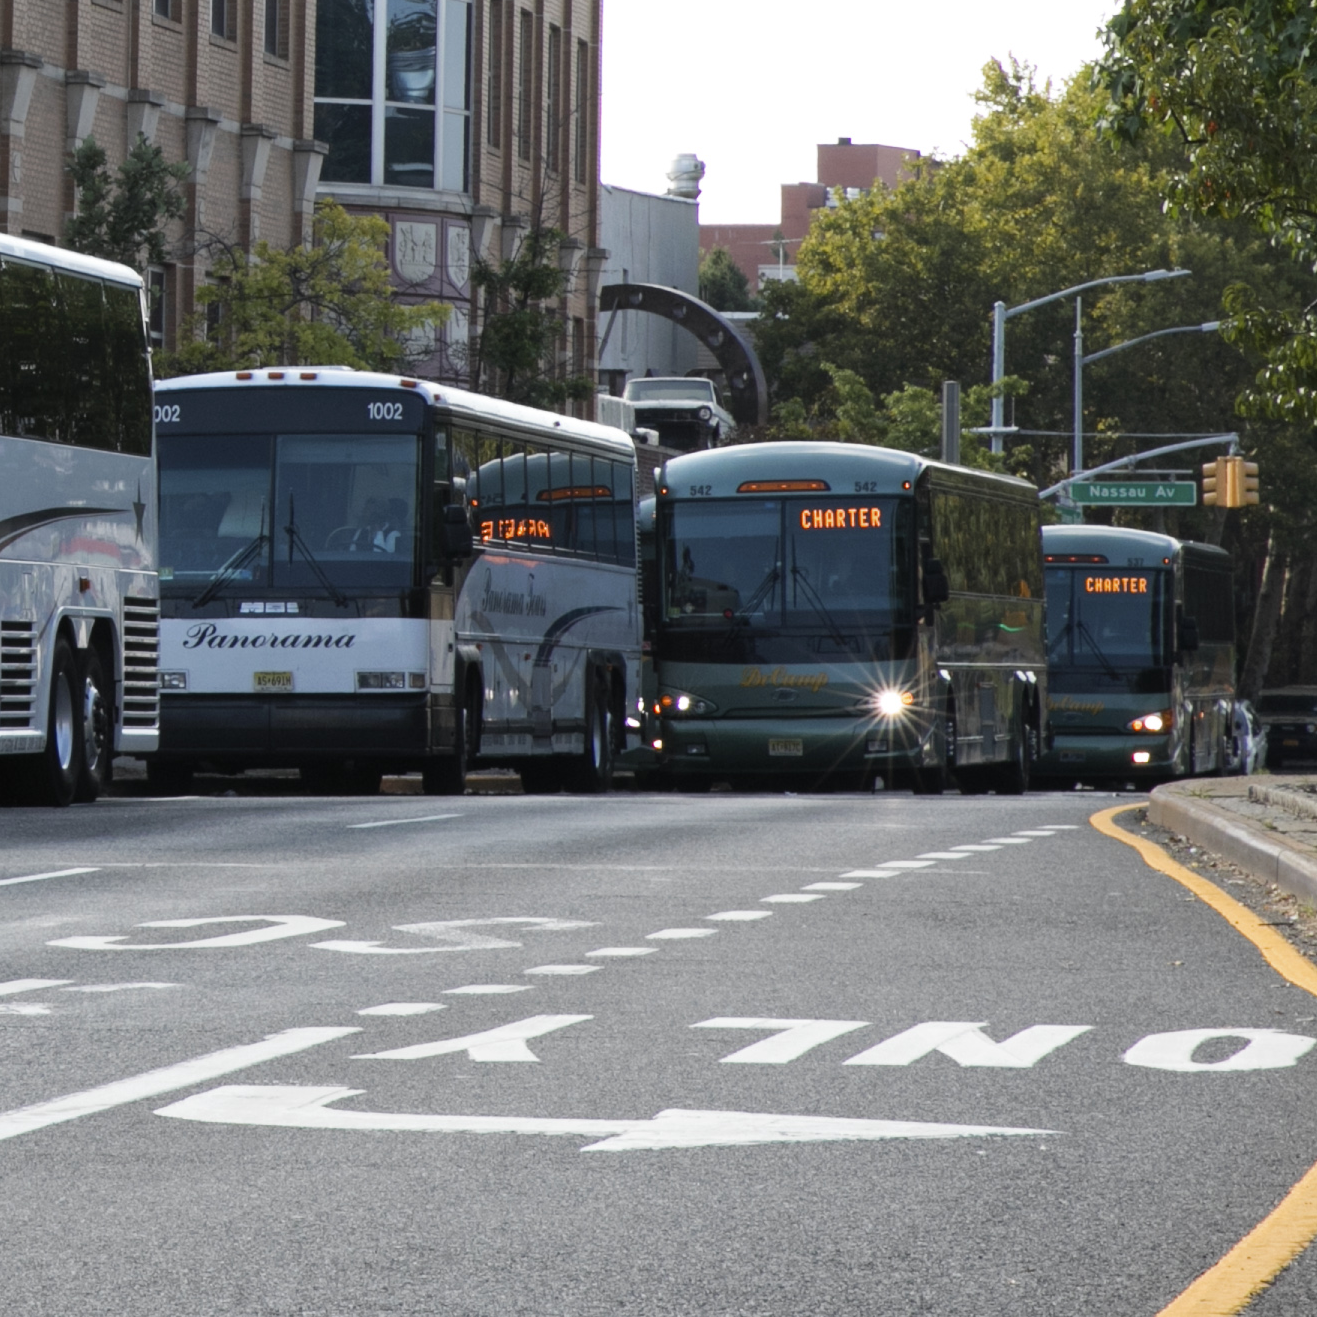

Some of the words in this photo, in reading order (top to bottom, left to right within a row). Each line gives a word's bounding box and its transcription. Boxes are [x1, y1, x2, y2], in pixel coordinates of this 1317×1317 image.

[154, 404, 181, 422] 002
[367, 402, 403, 420] 1002
[689, 485, 712, 496] 542
[854, 481, 877, 493] 542
[1089, 485, 1146, 498] Nassau
[1155, 486, 1176, 498] Av
[800, 507, 882, 530] CHARTER
[1127, 557, 1144, 567] 537
[1085, 577, 1148, 593] CHARTER
[182, 621, 357, 650] Panorama
[350, 1012, 1316, 1073] ONLY
